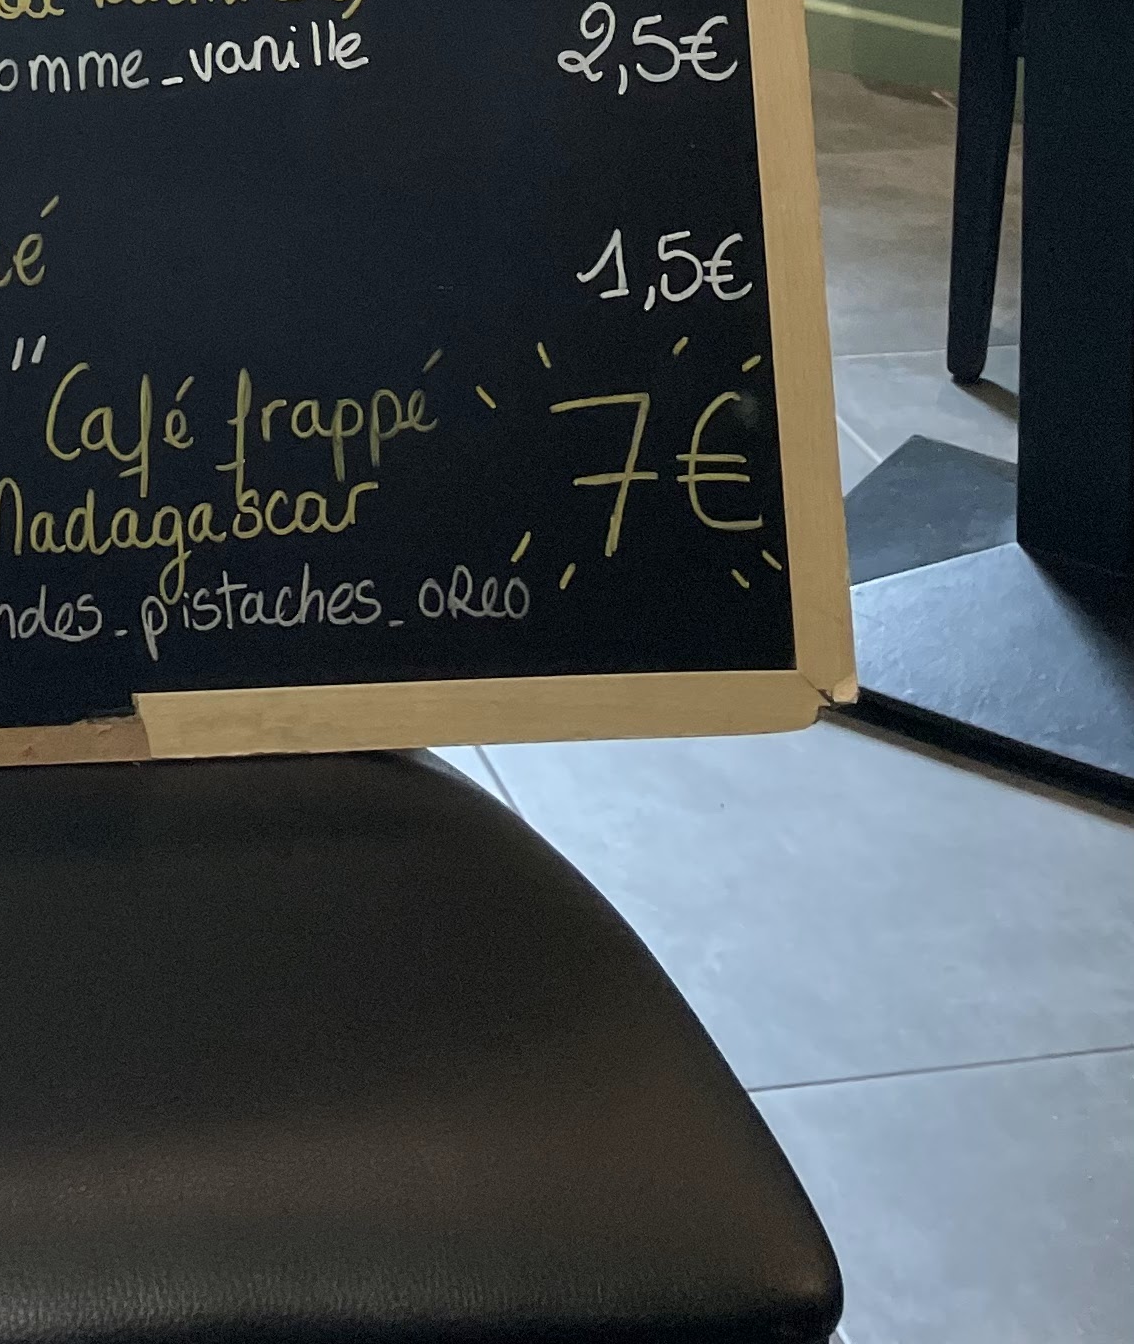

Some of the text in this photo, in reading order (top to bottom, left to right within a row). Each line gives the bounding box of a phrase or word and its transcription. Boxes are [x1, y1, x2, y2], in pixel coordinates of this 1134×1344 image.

[557, 1, 739, 96] 2,5€
[575, 228, 753, 312] 1,5€
[549, 391, 763, 558] 7€
